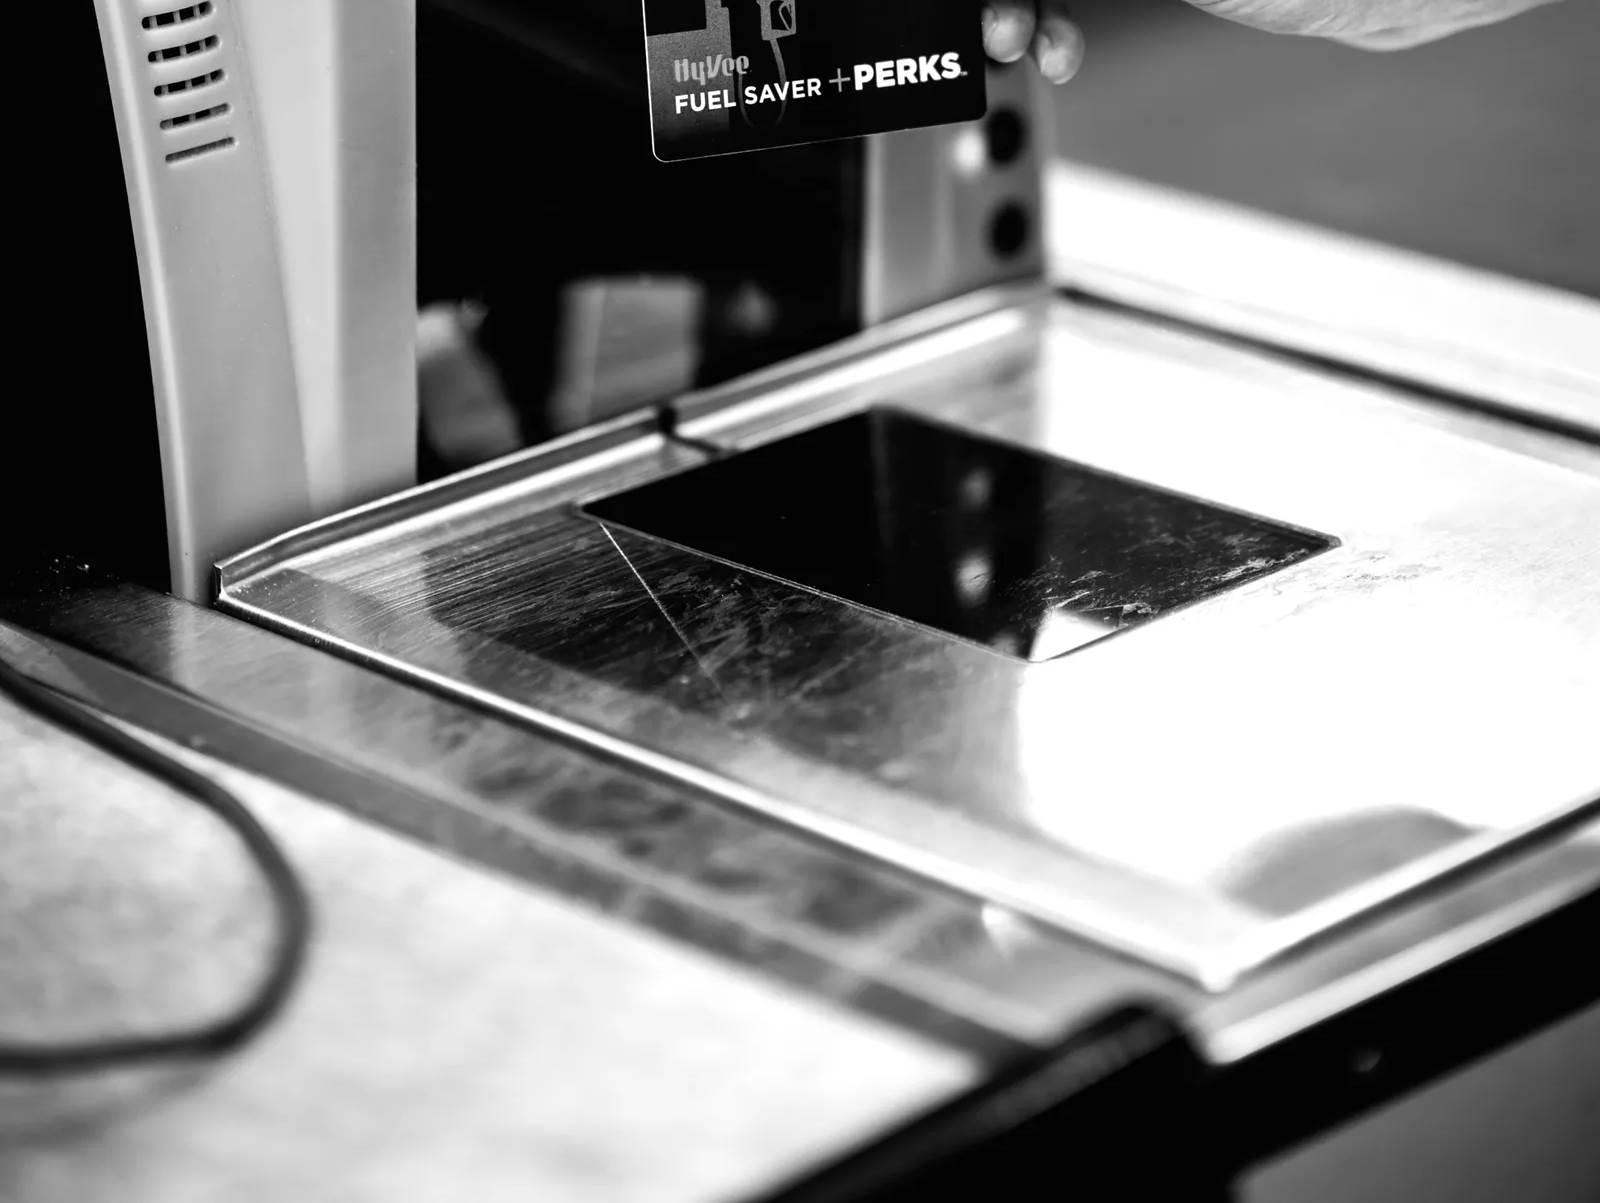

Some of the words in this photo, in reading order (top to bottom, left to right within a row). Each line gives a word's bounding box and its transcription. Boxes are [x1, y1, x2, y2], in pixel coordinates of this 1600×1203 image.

[674, 54, 750, 85] HyVee
[675, 89, 737, 114] FUEL
[744, 77, 822, 105] SAVER
